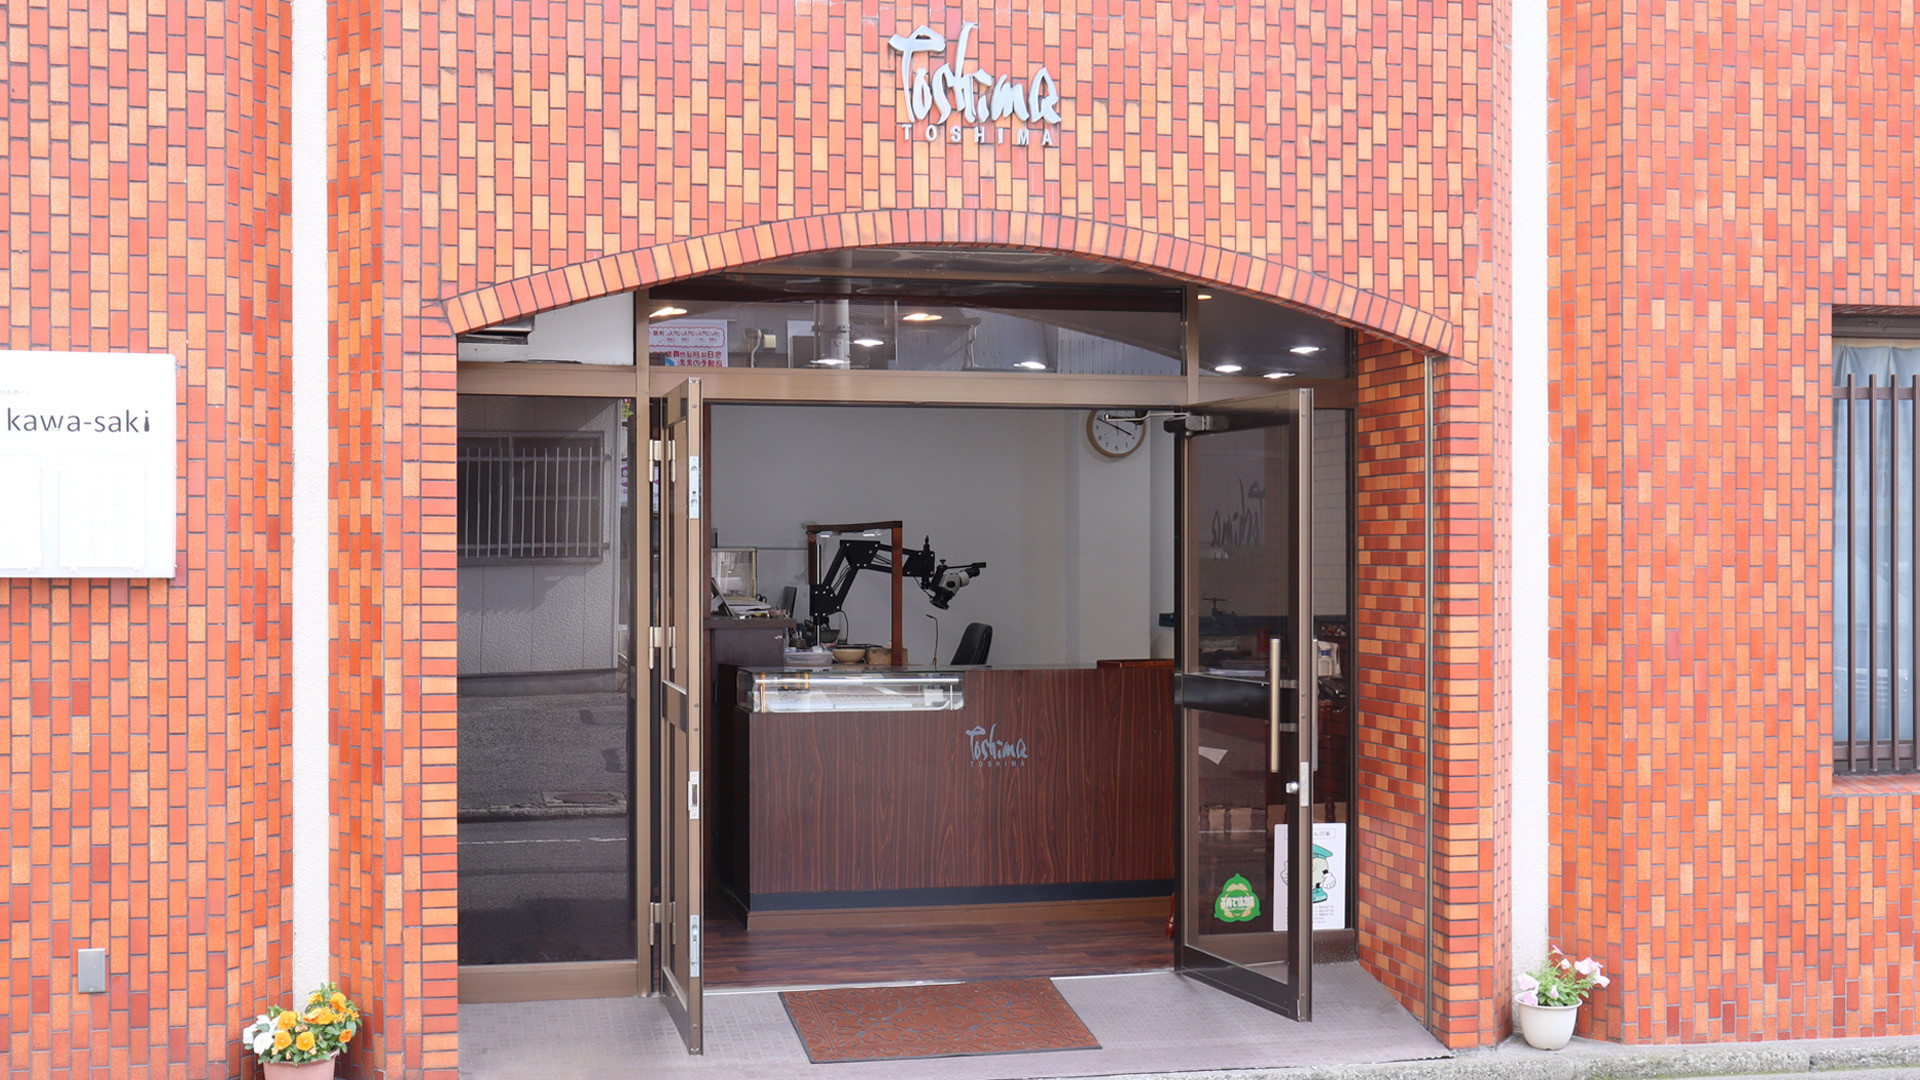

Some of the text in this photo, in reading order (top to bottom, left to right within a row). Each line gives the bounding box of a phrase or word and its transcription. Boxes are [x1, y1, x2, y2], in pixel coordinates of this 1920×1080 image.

[888, 22, 1062, 124] Toshima
[901, 123, 1053, 146] TOSHIMA
[7, 407, 150, 433] kawa-saki
[965, 723, 1028, 761] Toshima
[970, 760, 1025, 768] TOSHIMA
